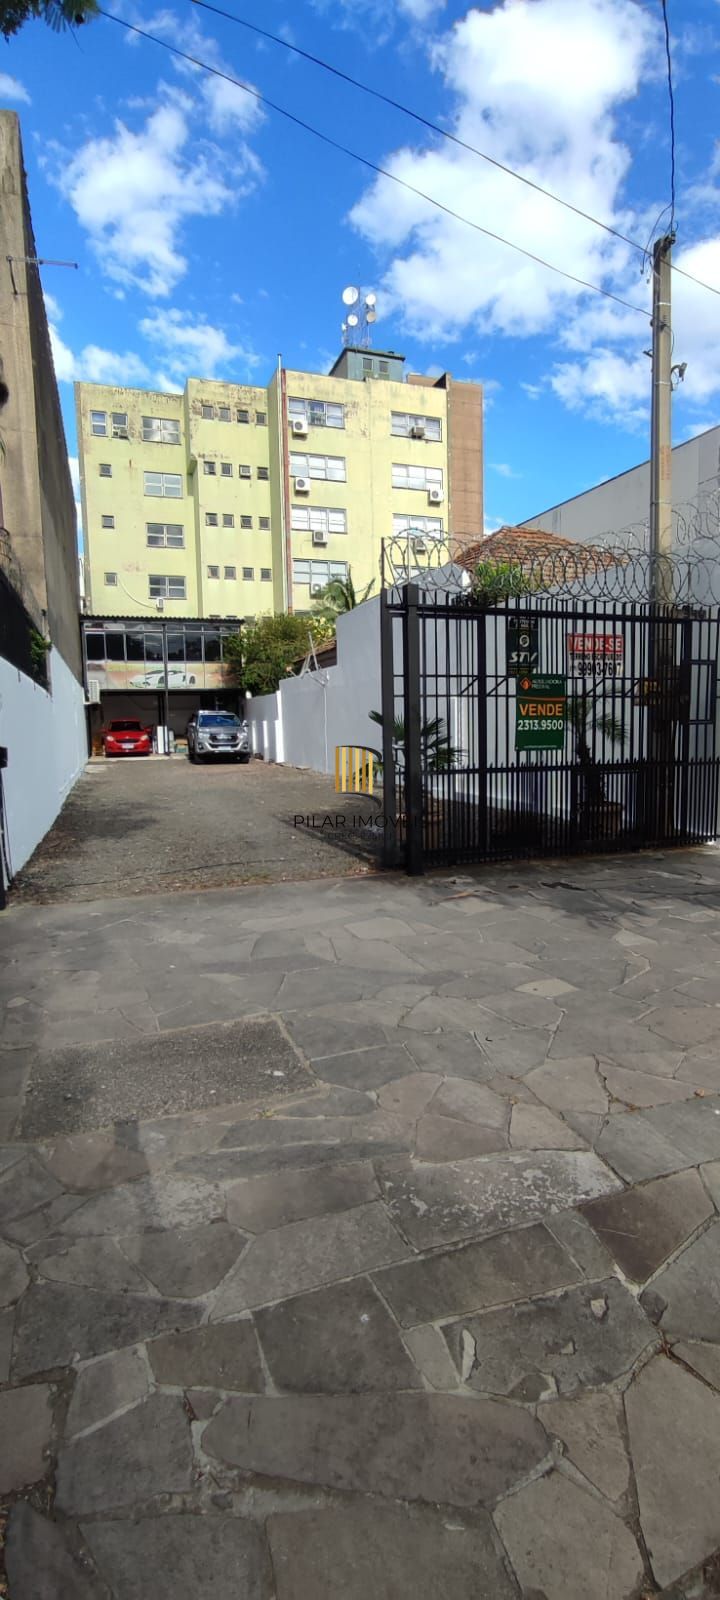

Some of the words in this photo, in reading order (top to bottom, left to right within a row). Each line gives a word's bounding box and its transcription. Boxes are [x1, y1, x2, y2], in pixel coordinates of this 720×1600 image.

[509, 651, 538, 663] STV
[519, 703, 563, 716] VENDE
[517, 719, 564, 731] 2313.9500
